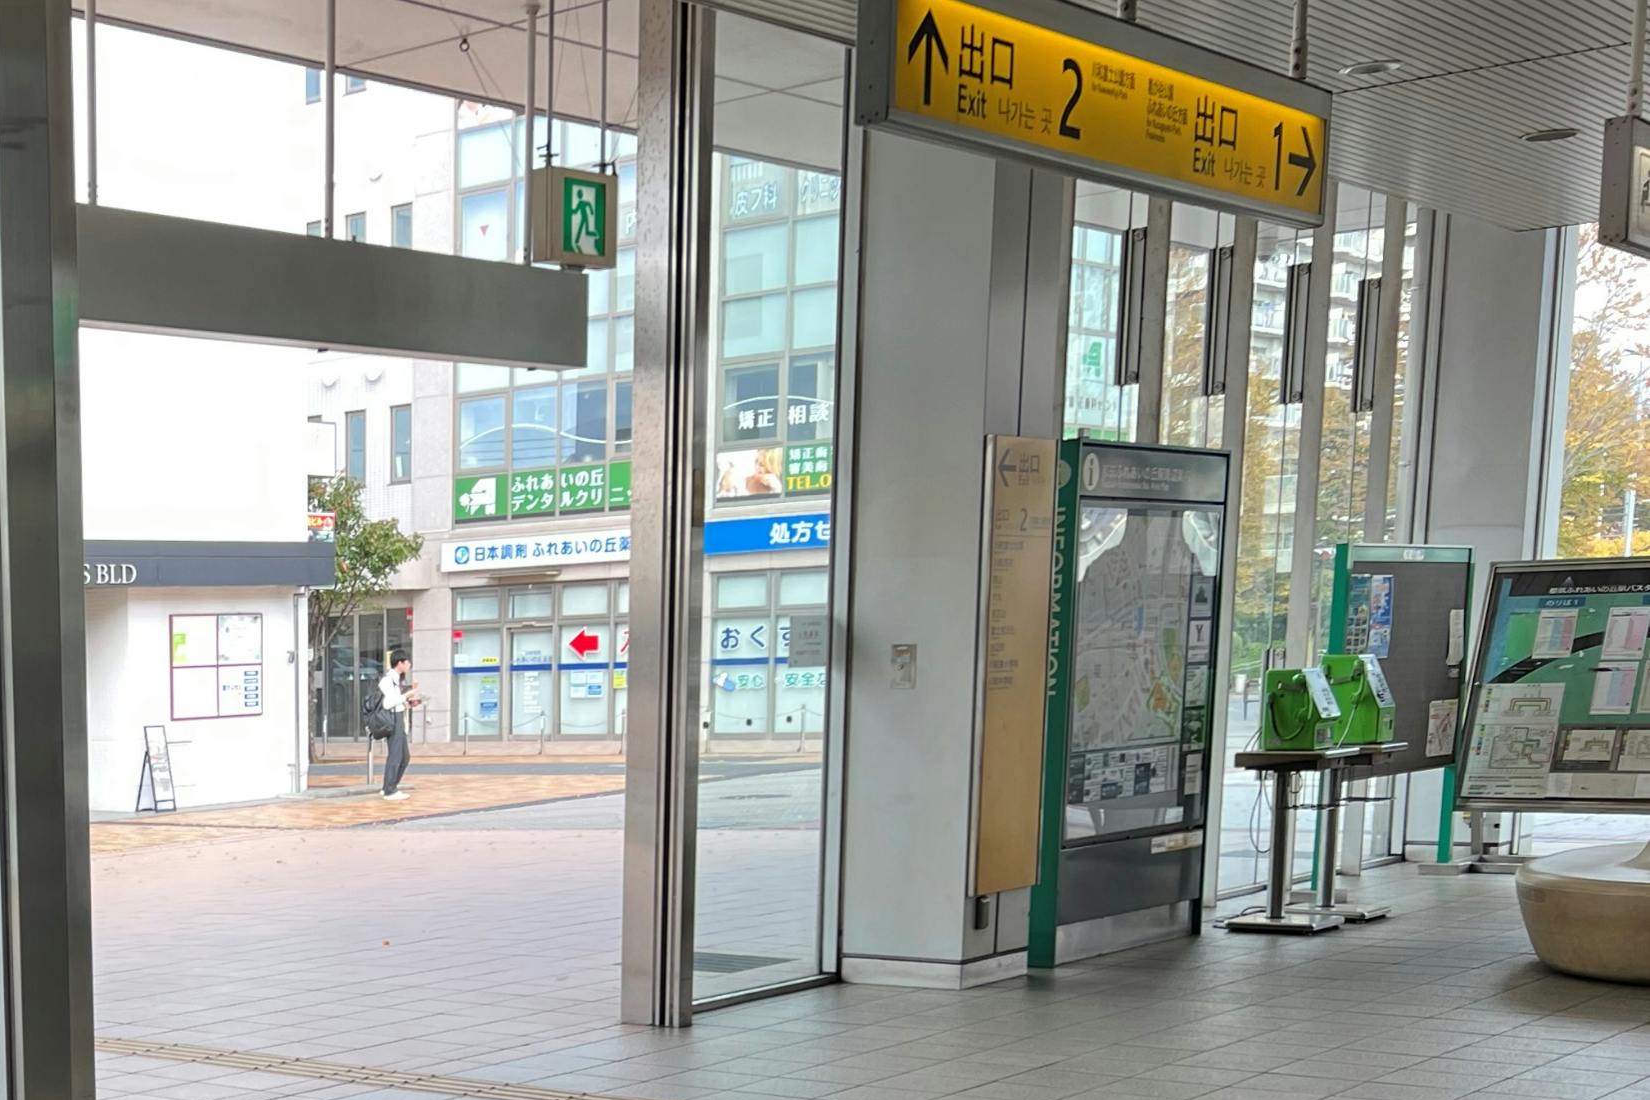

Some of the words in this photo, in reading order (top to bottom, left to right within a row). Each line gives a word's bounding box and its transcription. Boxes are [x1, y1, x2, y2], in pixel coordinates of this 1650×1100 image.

[958, 23, 1014, 90] 出口
[957, 84, 988, 119] Exit
[1059, 57, 1083, 140] 2
[998, 98, 1037, 130] 나가는
[1038, 107, 1053, 135] 곳
[1195, 96, 1238, 151] 出口
[1192, 147, 1215, 177] Exit
[1224, 158, 1253, 185] 나가는
[1272, 122, 1283, 191] 1
[511, 468, 604, 492] ふれあいの丘
[511, 487, 632, 512] デンタルクリニ
[475, 543, 527, 562] 日本調剤
[96, 563, 136, 584] BLD
[1047, 507, 1066, 696] INFORMATION
